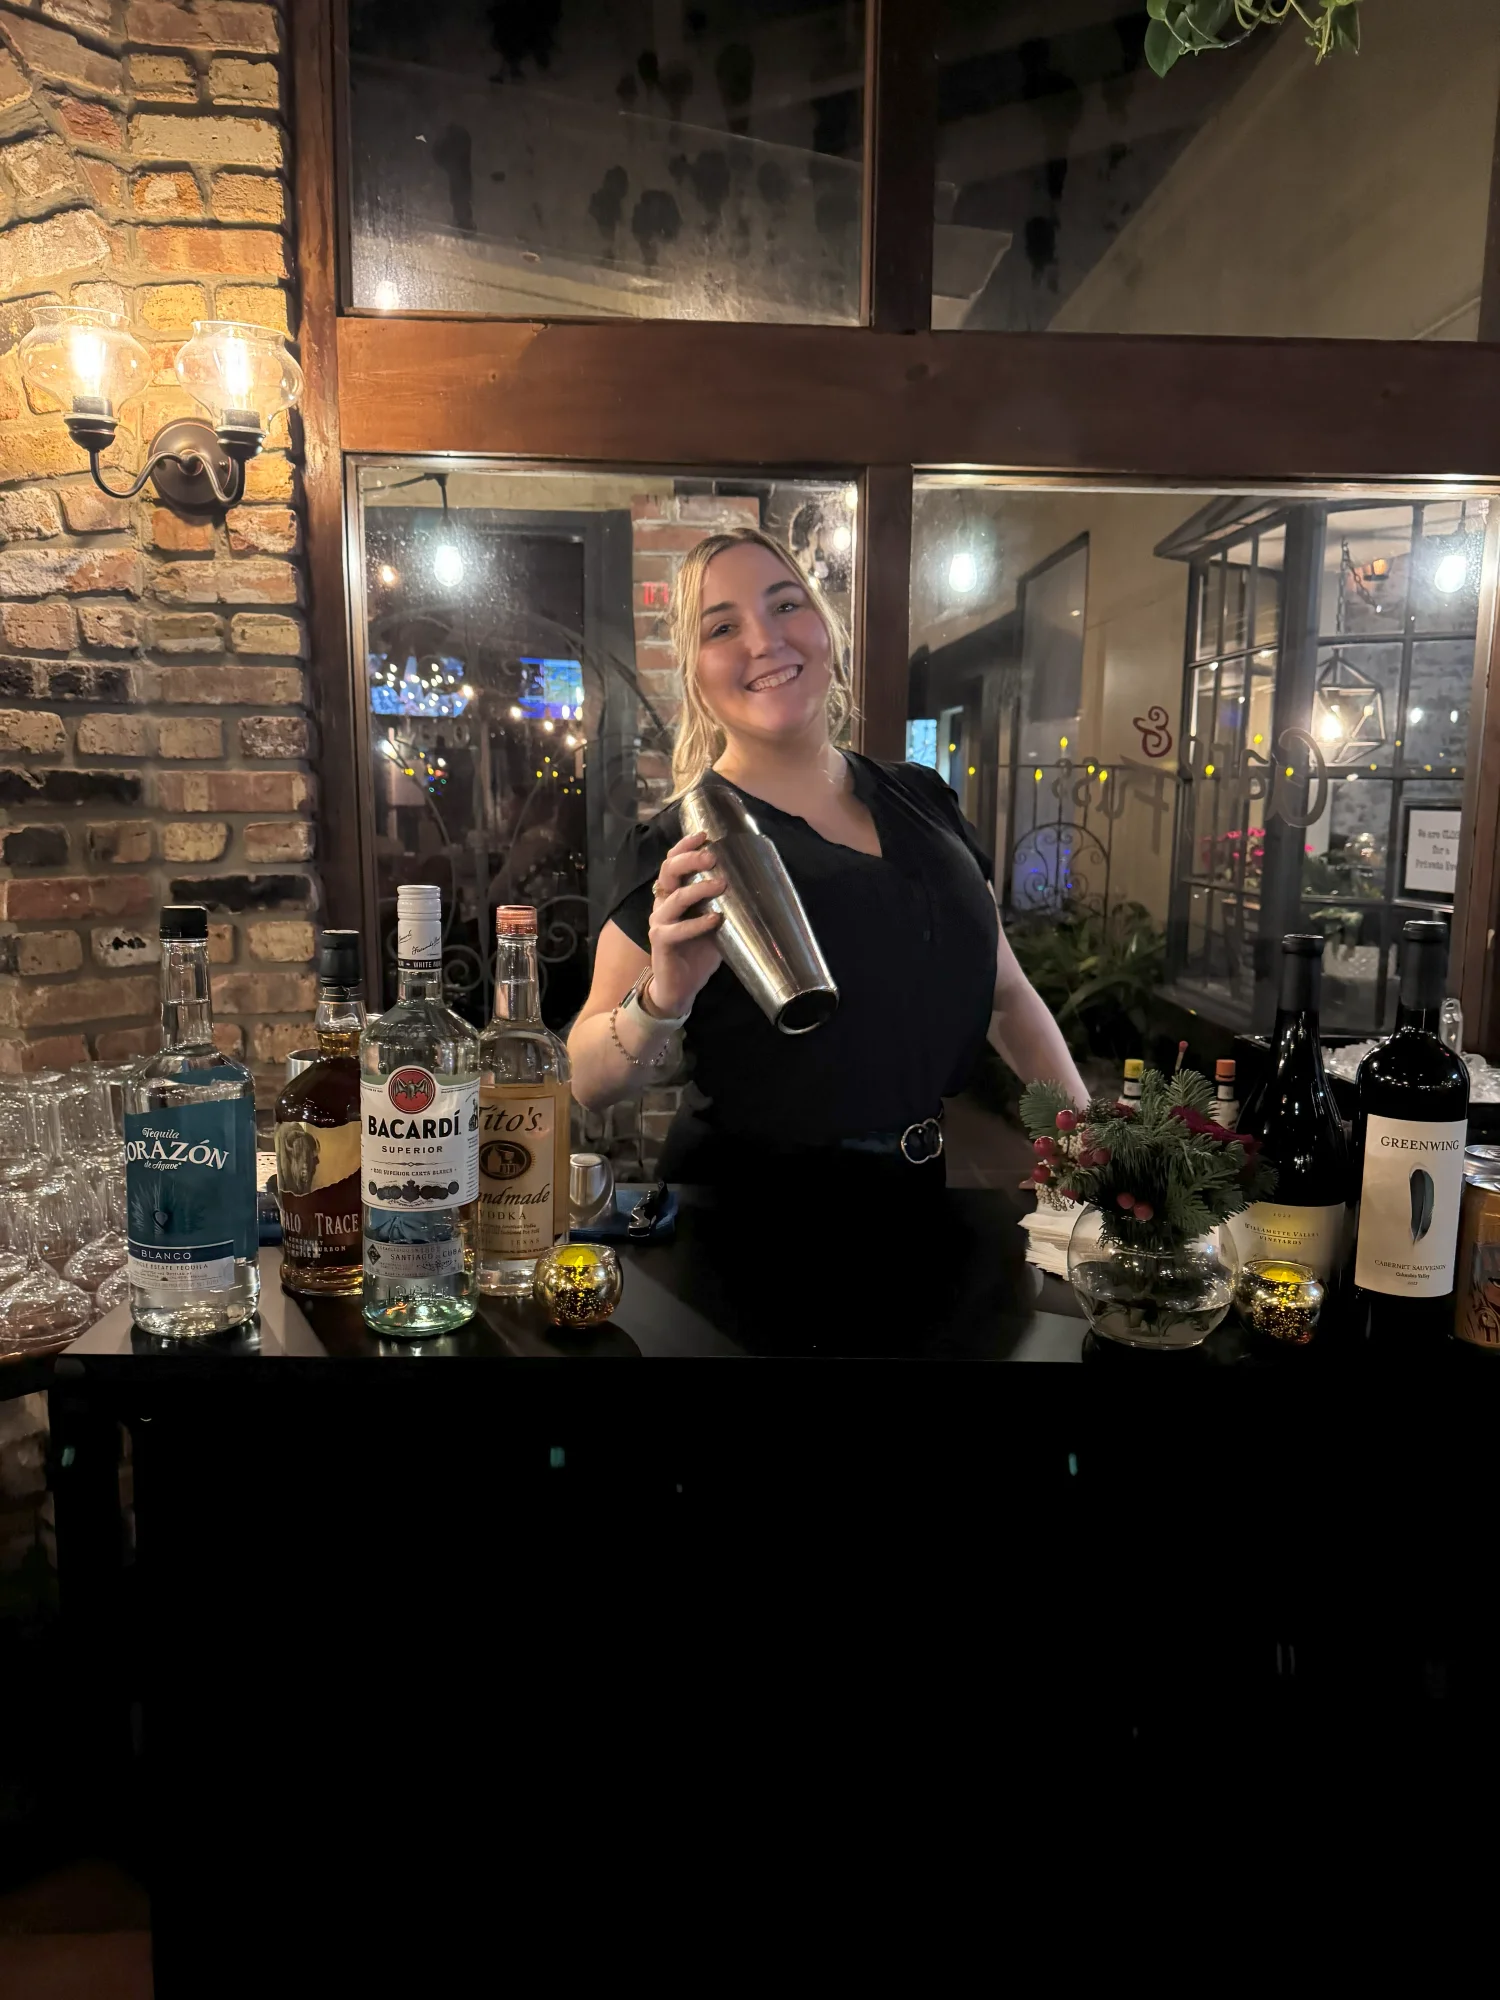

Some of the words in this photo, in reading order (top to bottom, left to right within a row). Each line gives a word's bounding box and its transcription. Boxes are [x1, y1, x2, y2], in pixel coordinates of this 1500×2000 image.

[368, 1109, 460, 1139] BACARDÍ
[142, 1127, 180, 1140] Tequila
[382, 1145, 443, 1154] SUPERIOR
[1380, 1136, 1459, 1150] GREENWING
[144, 1161, 151, 1169] de
[478, 1183, 550, 1205] ndmade
[479, 1210, 526, 1220] VODKA
[314, 1212, 359, 1237] TRACE
[1244, 1223, 1290, 1236] WILLAMETTE
[1259, 1235, 1302, 1245] VINEYARDS
[141, 1249, 191, 1260] BLANCO
[390, 1253, 434, 1261] SANTIAGO
[442, 1248, 462, 1258] CUBA
[1374, 1260, 1410, 1270] CABERNET
